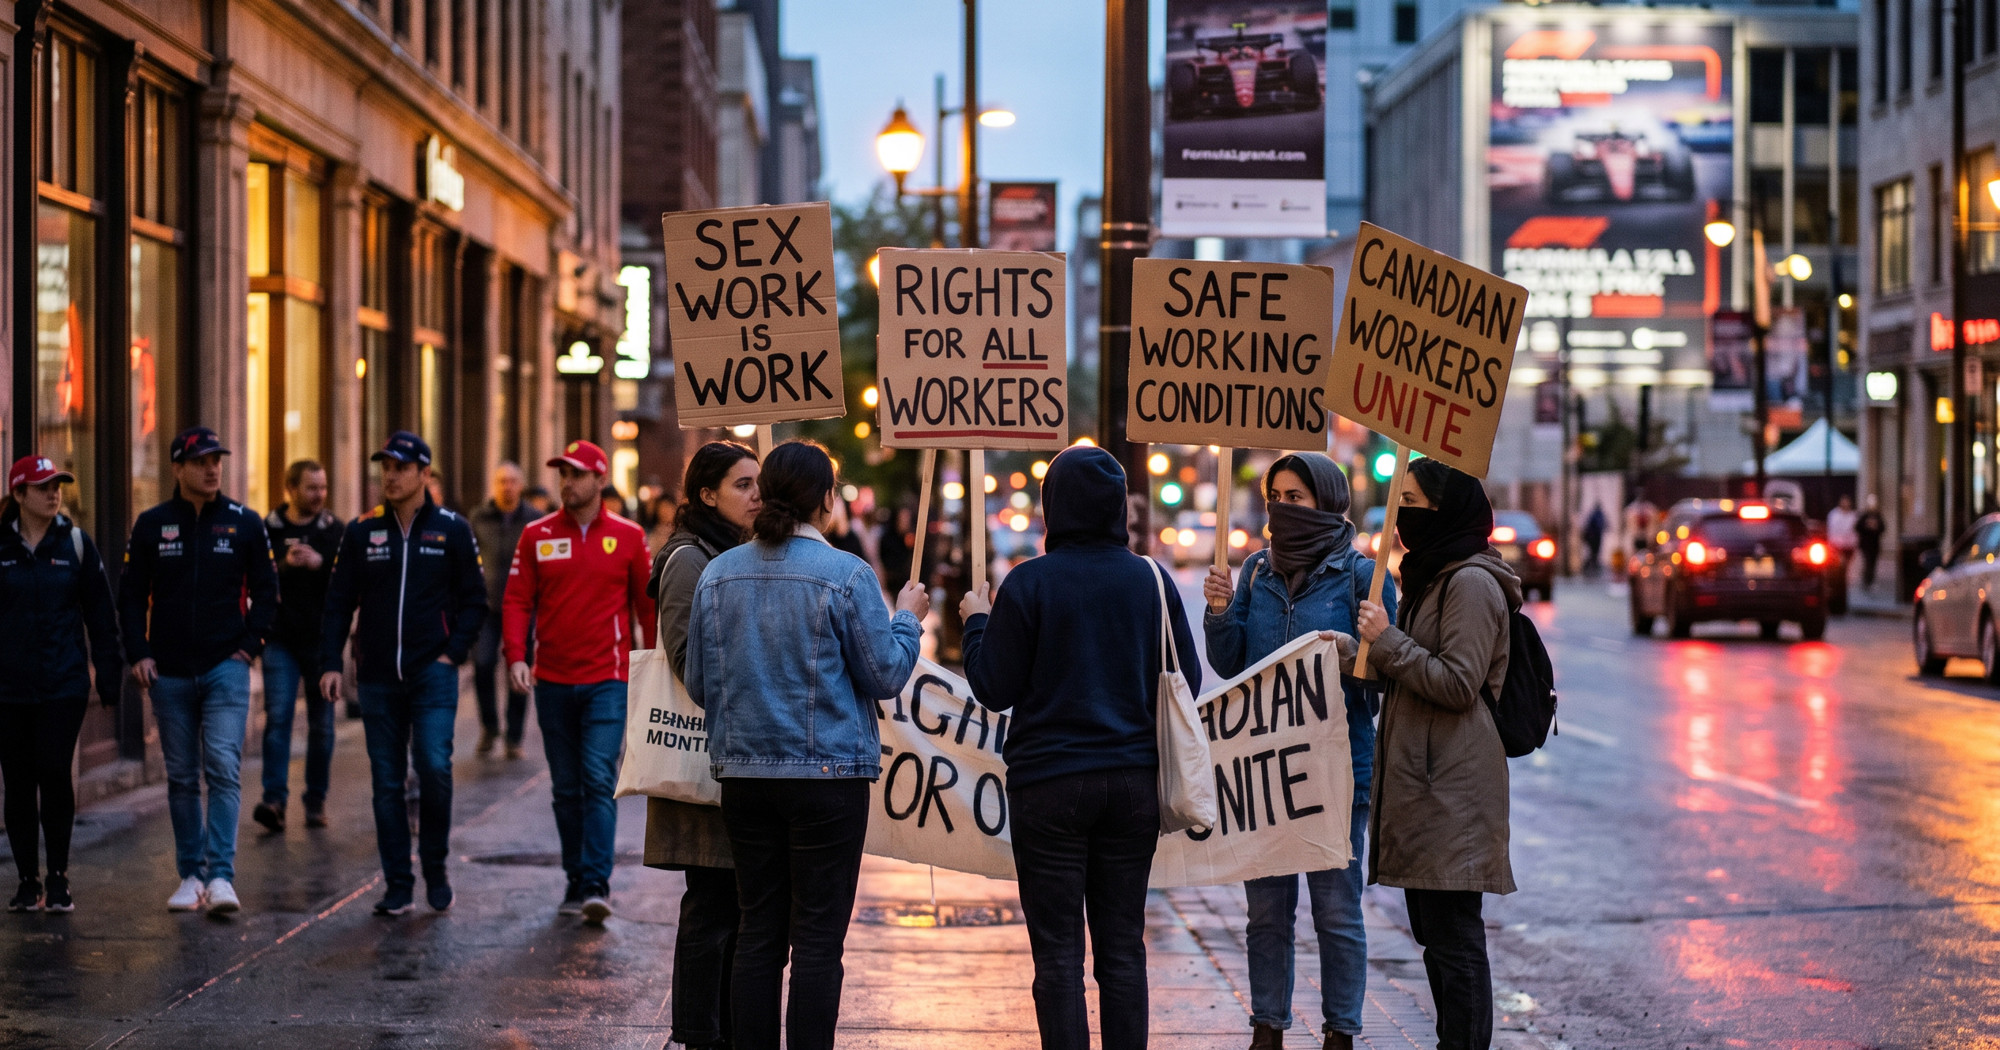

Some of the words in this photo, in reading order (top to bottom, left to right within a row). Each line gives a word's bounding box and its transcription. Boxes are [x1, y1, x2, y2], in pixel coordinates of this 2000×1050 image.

[695, 216, 803, 271] SEX
[675, 270, 826, 322] WORK
[896, 264, 1052, 318] RIGHTS
[1164, 267, 1288, 321] SAFE
[1359, 238, 1517, 345] CANADIAN
[741, 324, 771, 351] IS
[905, 328, 966, 358] FOR
[982, 328, 1048, 360] ALL
[1139, 327, 1321, 375] WORKING
[1350, 297, 1502, 408] WORKERS
[684, 350, 833, 406] WORK
[884, 376, 1065, 427] WORKERS
[1136, 379, 1325, 434] CONDITIONS
[1353, 363, 1471, 458] UNITE
[1184, 743, 1325, 841] NITE
